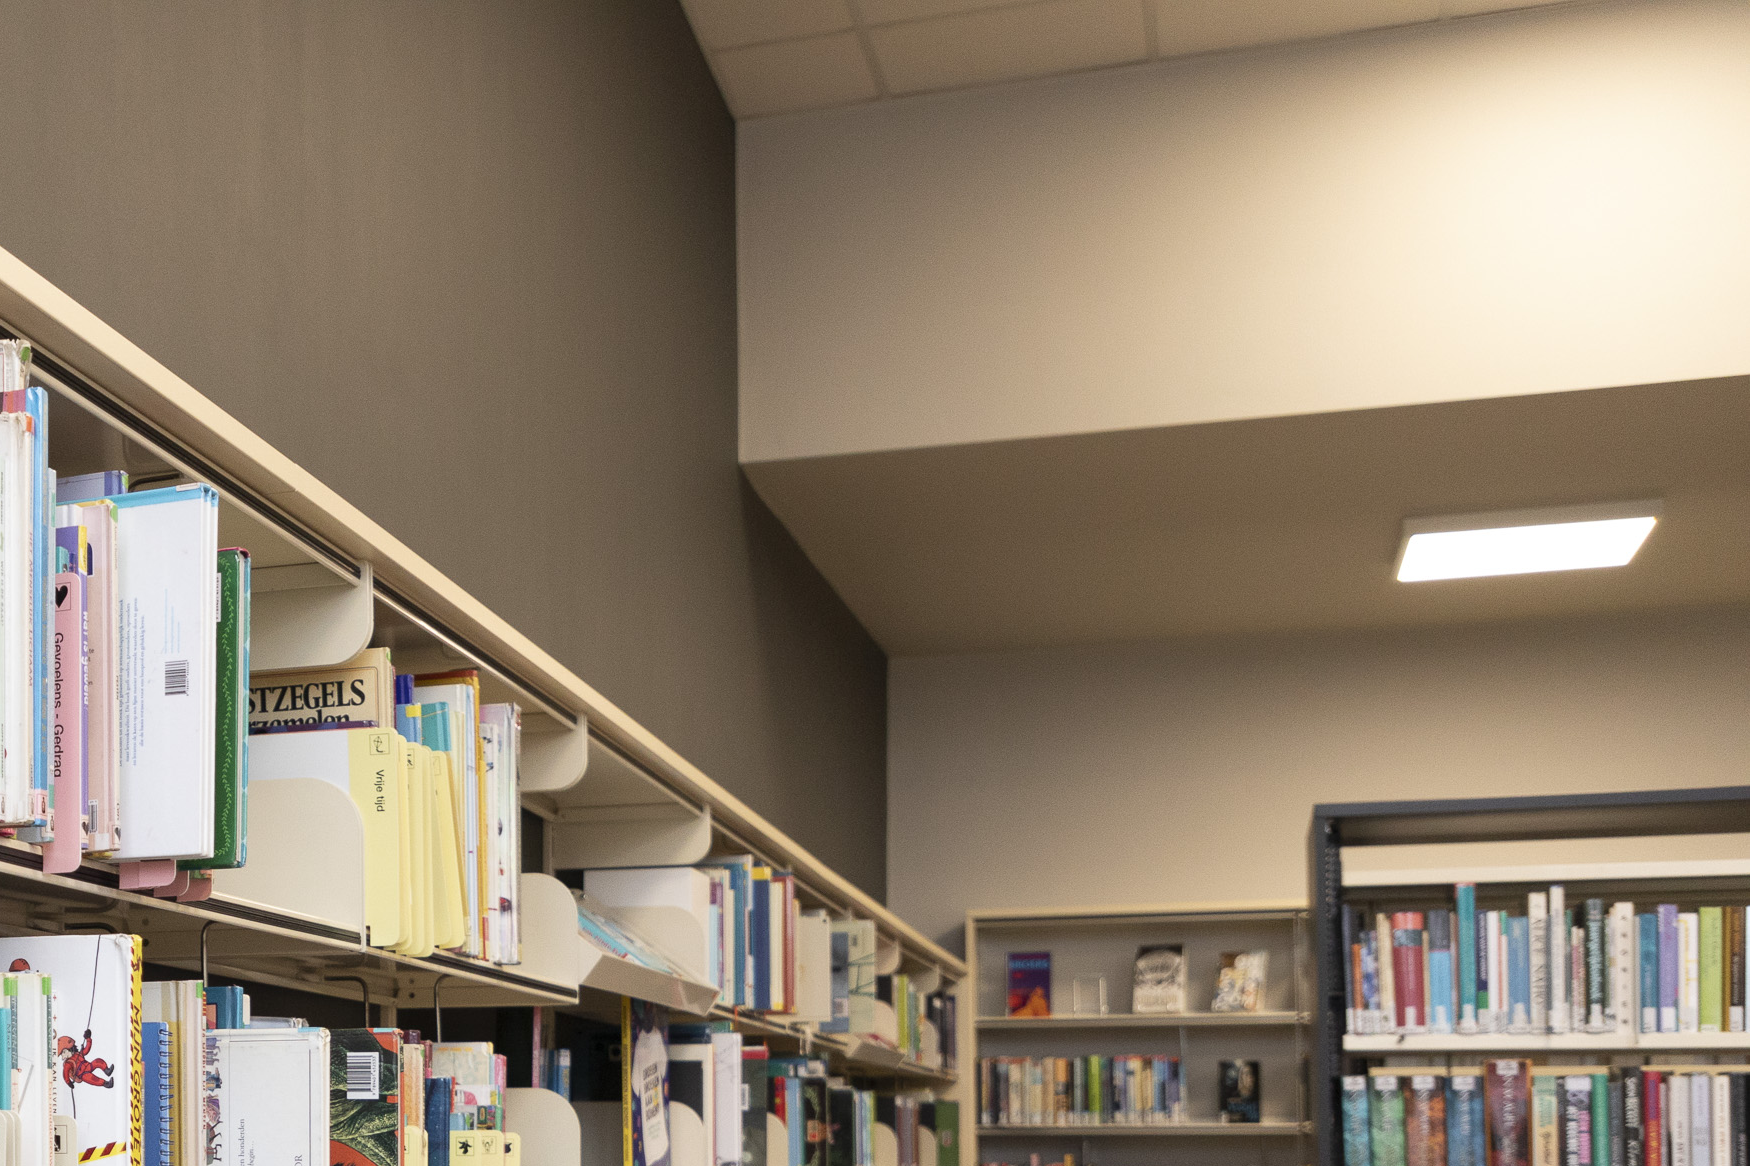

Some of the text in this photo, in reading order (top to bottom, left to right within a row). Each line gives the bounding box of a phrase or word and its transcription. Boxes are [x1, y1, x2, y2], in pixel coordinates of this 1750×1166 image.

[54, 632, 64, 709] Gevoelens
[248, 678, 366, 714] STZEGELS
[375, 769, 386, 813] Vrije tijd
[130, 1005, 141, 1062] MIJN
[130, 1065, 142, 1150] GROTE
